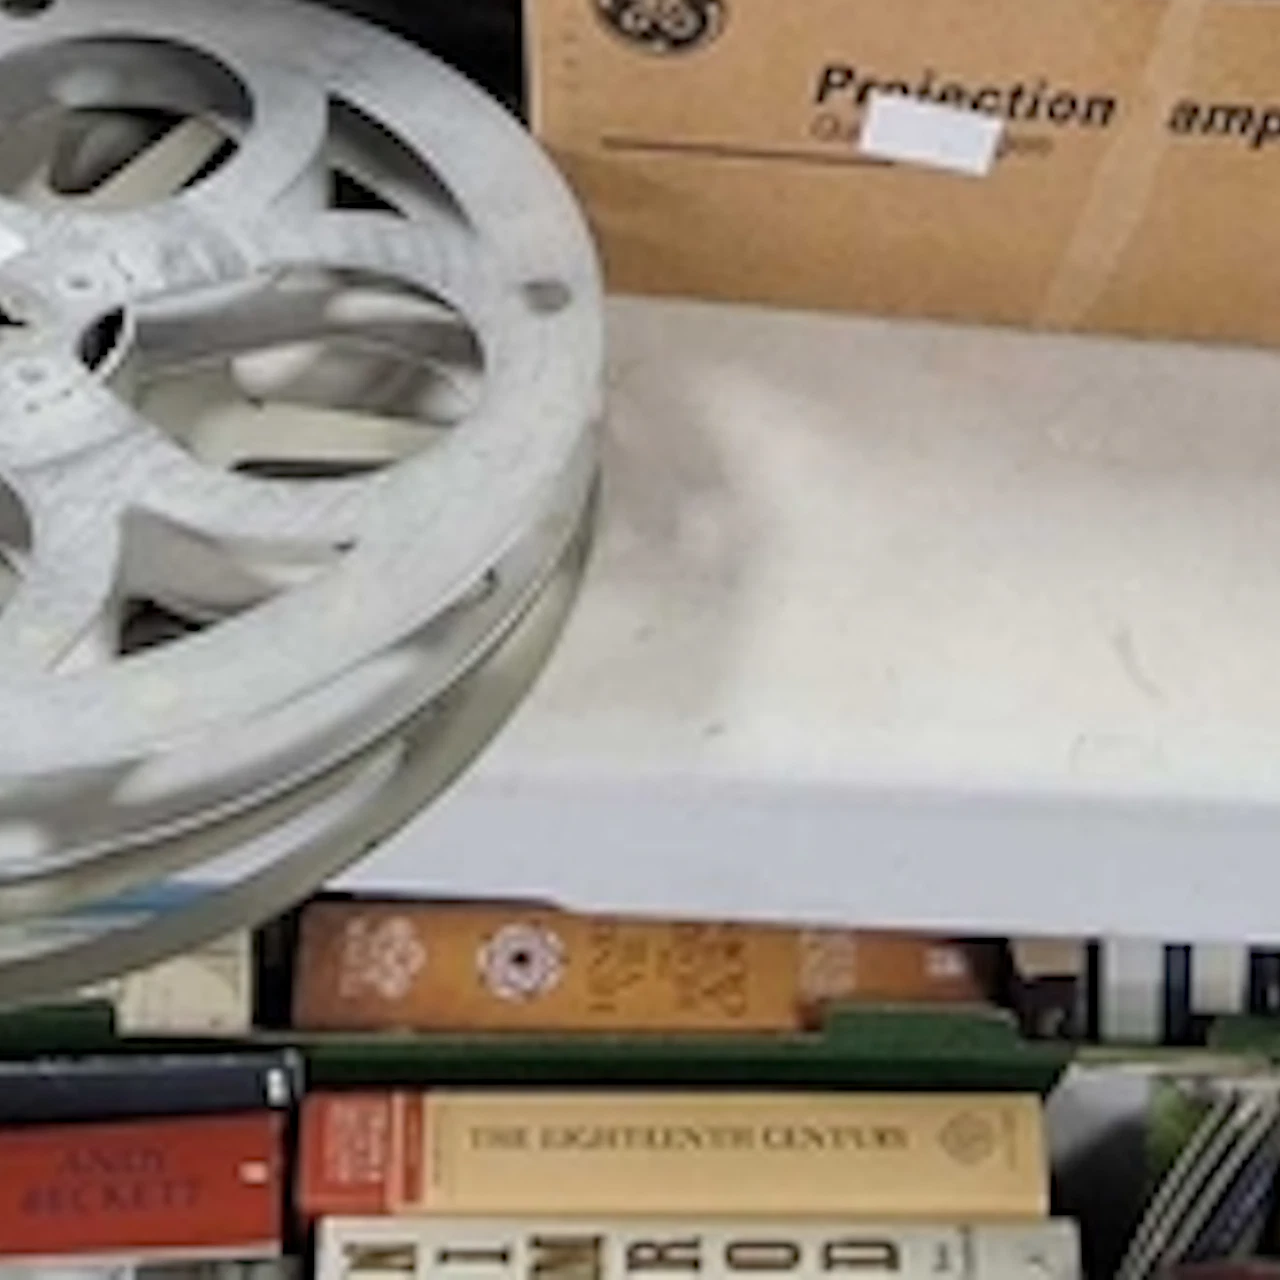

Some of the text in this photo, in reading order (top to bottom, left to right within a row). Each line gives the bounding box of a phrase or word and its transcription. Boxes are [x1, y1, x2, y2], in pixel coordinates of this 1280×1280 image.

[469, 1123, 908, 1152] THE EIGHTEENTH CENTURY
[20, 1178, 202, 1215] BECKETT
